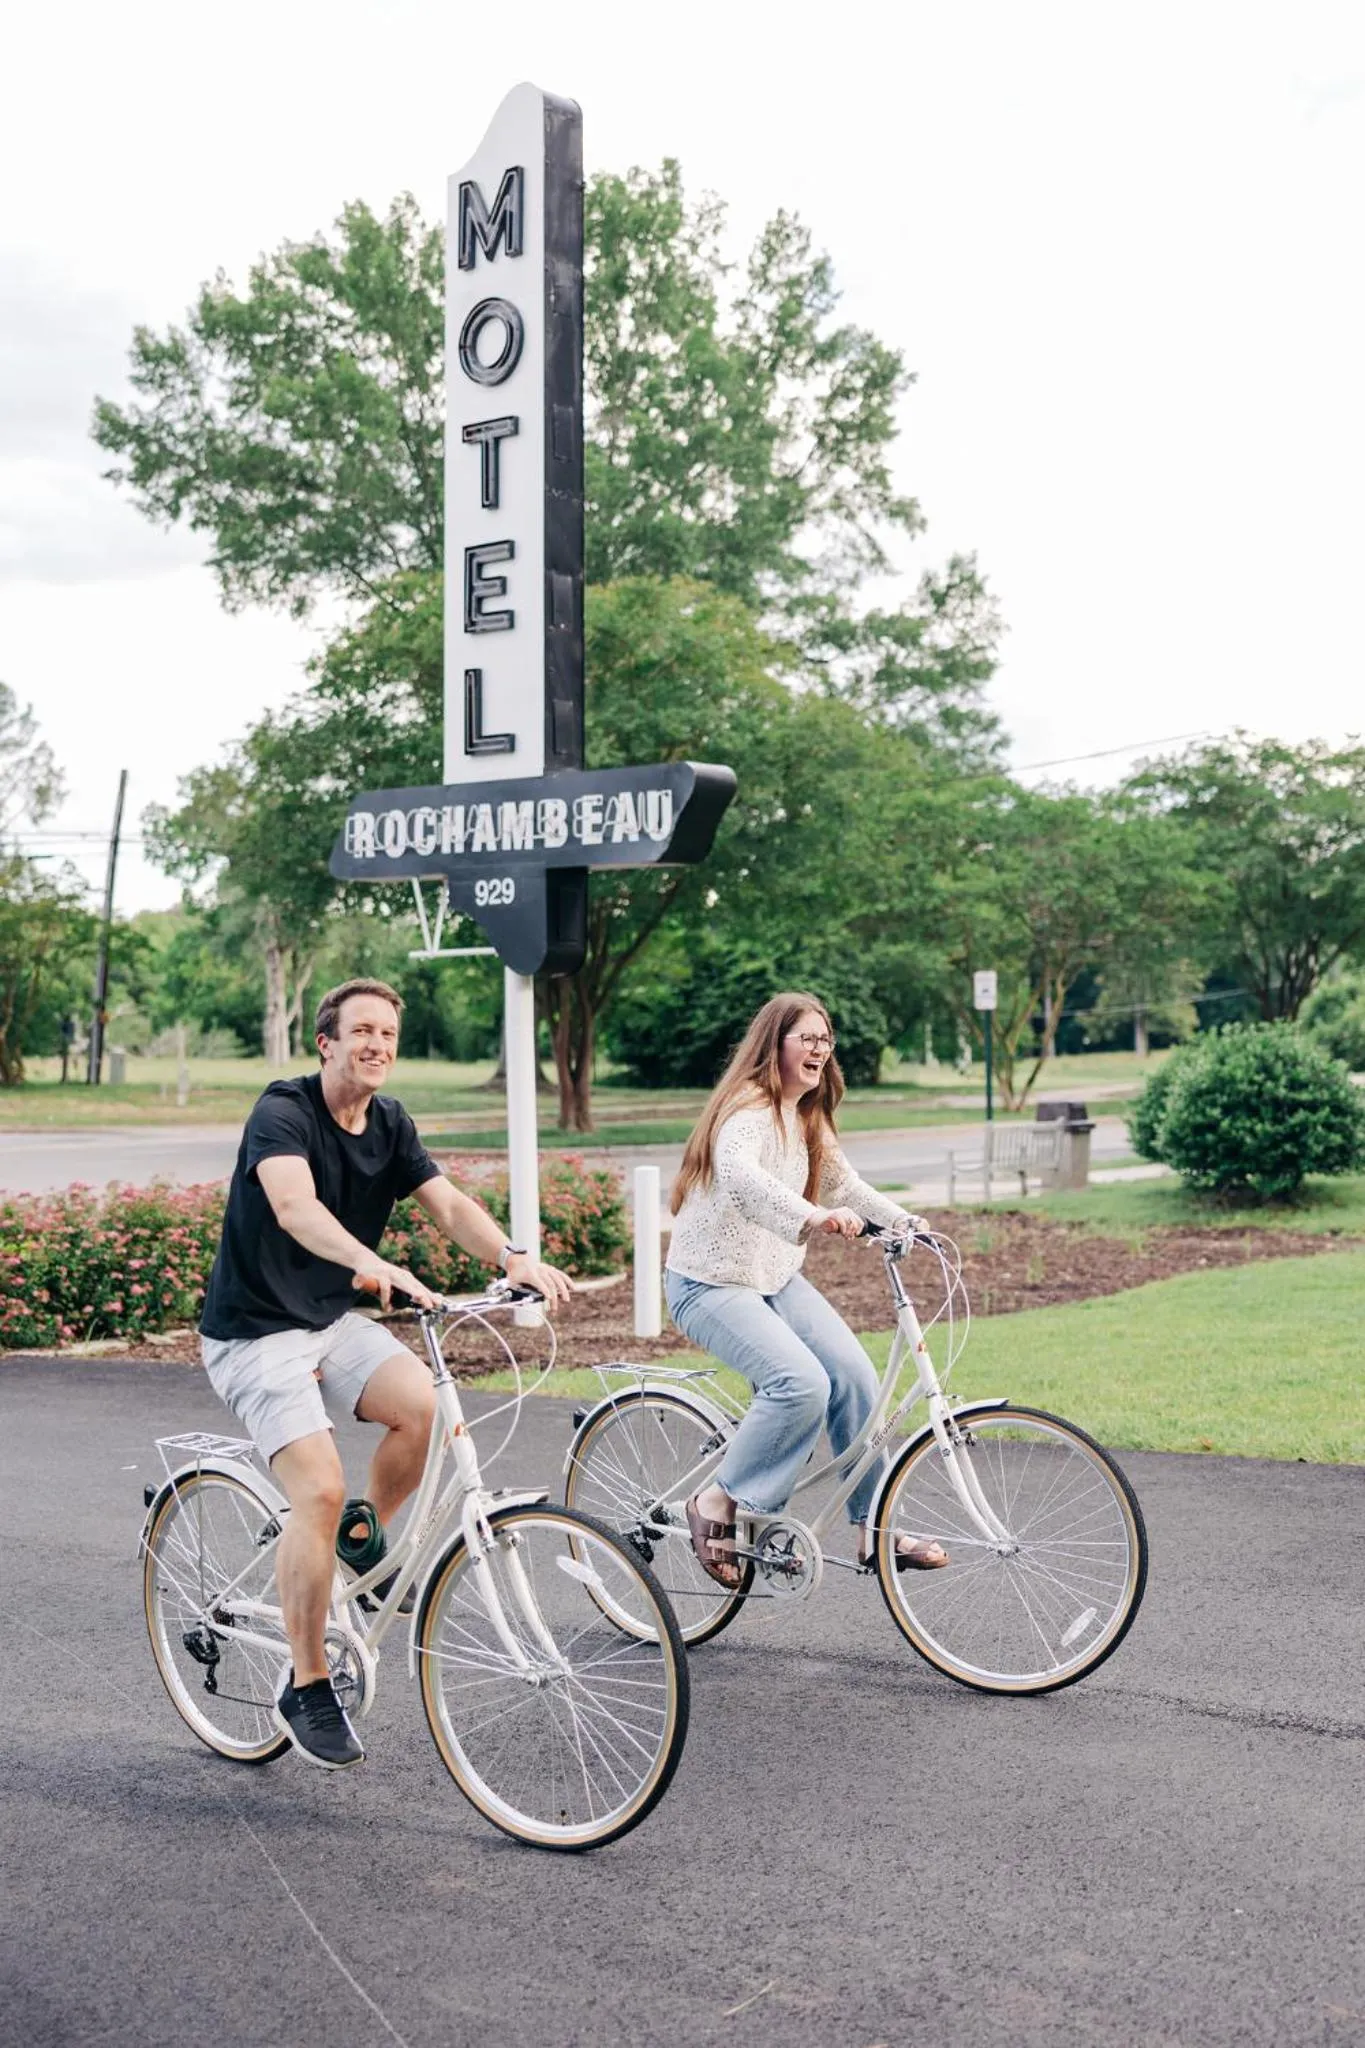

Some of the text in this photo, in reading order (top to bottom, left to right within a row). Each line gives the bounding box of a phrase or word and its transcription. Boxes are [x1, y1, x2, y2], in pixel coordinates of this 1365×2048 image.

[458, 166, 525, 756] MOTEL
[347, 789, 673, 858] ROCHAMBEAU
[474, 878, 516, 906] 929
